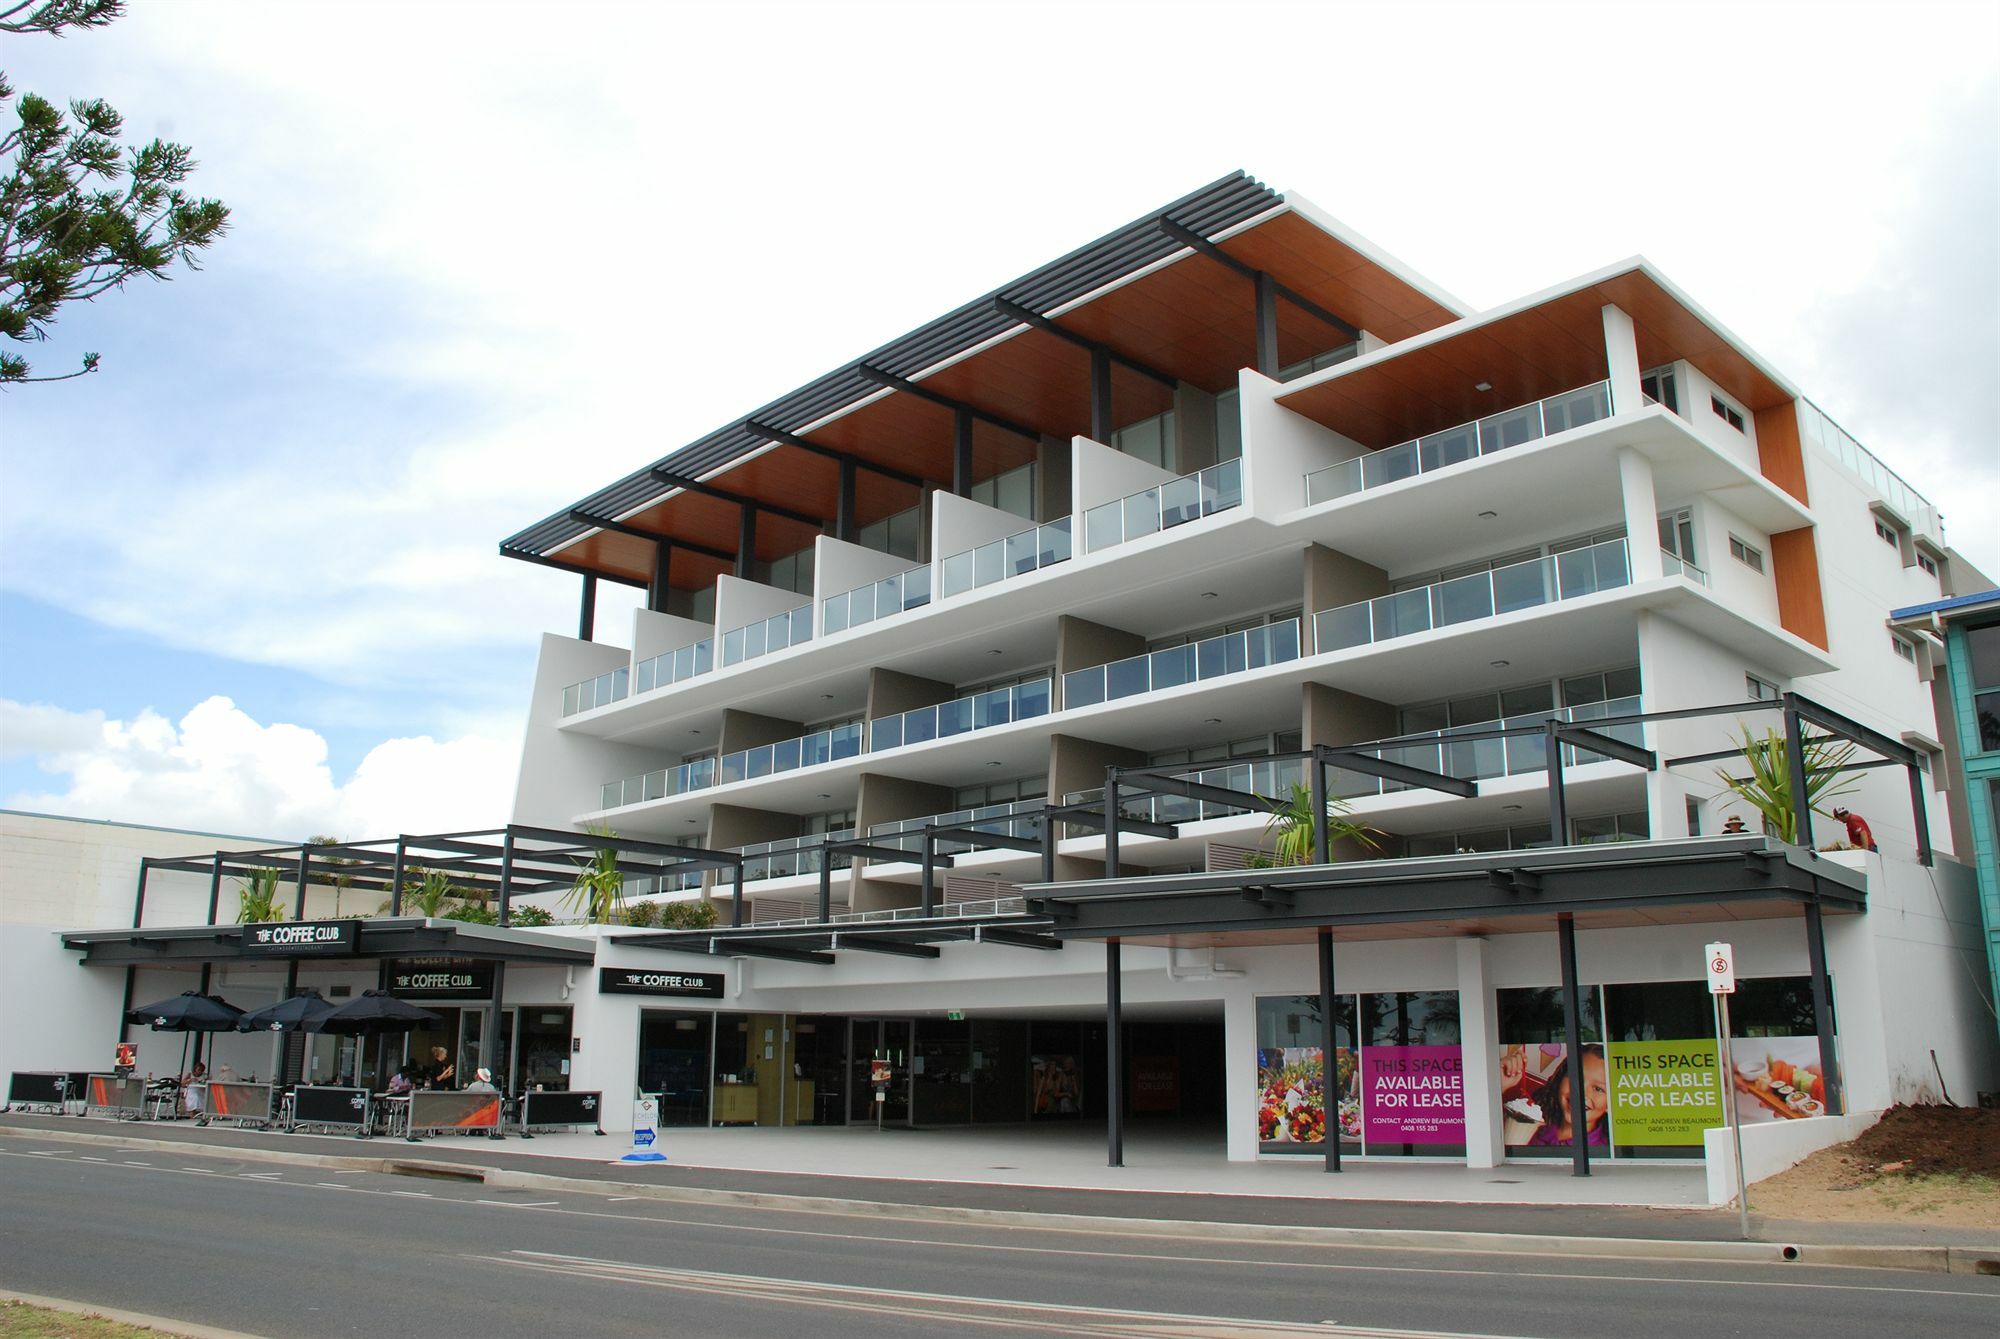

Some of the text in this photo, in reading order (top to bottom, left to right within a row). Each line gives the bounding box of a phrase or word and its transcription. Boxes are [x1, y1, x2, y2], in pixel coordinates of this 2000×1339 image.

[256, 926, 339, 944] THE COFFEE CLUB
[396, 974, 473, 988] THE COFFEE CLUB
[626, 974, 704, 987] THE COFFEE CLUB
[1374, 1058, 1463, 1072] THIS SPACE
[1613, 1053, 1715, 1070] THIS SPACE
[1375, 1075, 1461, 1090] AVAILABLE
[1617, 1072, 1714, 1089] AVAILABLE
[1376, 1093, 1462, 1107] FOR LEASE
[1618, 1090, 1717, 1108] FOR LEASE
[1682, 1117, 1721, 1125] BEAUMONT
